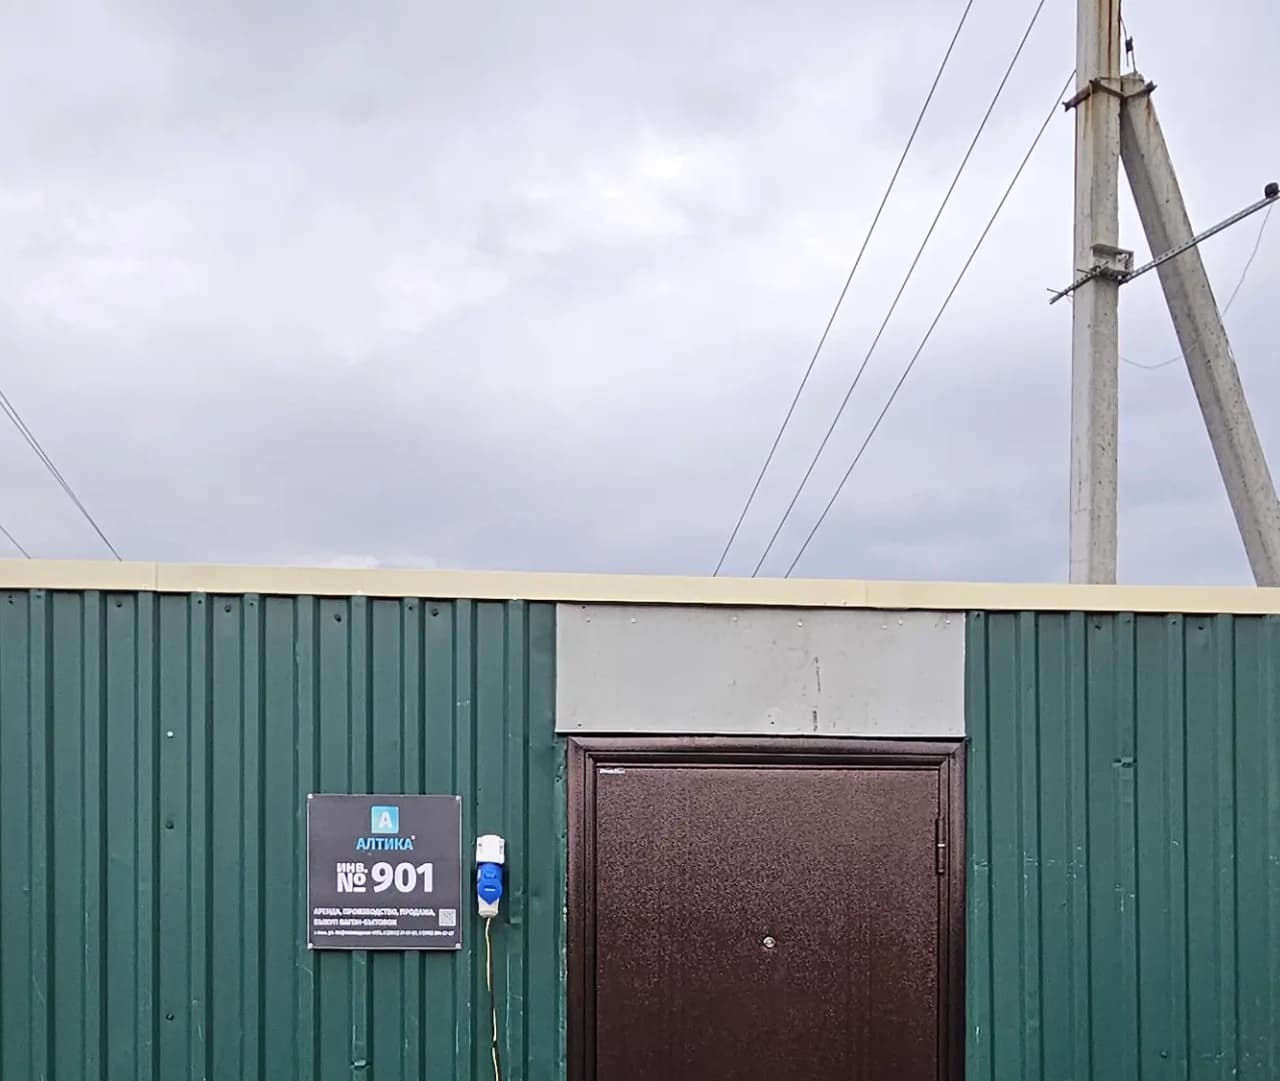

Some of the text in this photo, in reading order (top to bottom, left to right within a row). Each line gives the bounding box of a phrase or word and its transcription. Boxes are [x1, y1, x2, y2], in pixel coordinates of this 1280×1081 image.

[356, 837, 414, 850] АЛТИКА
[336, 862, 368, 873] ИНВ.
[336, 861, 433, 893] № 901
